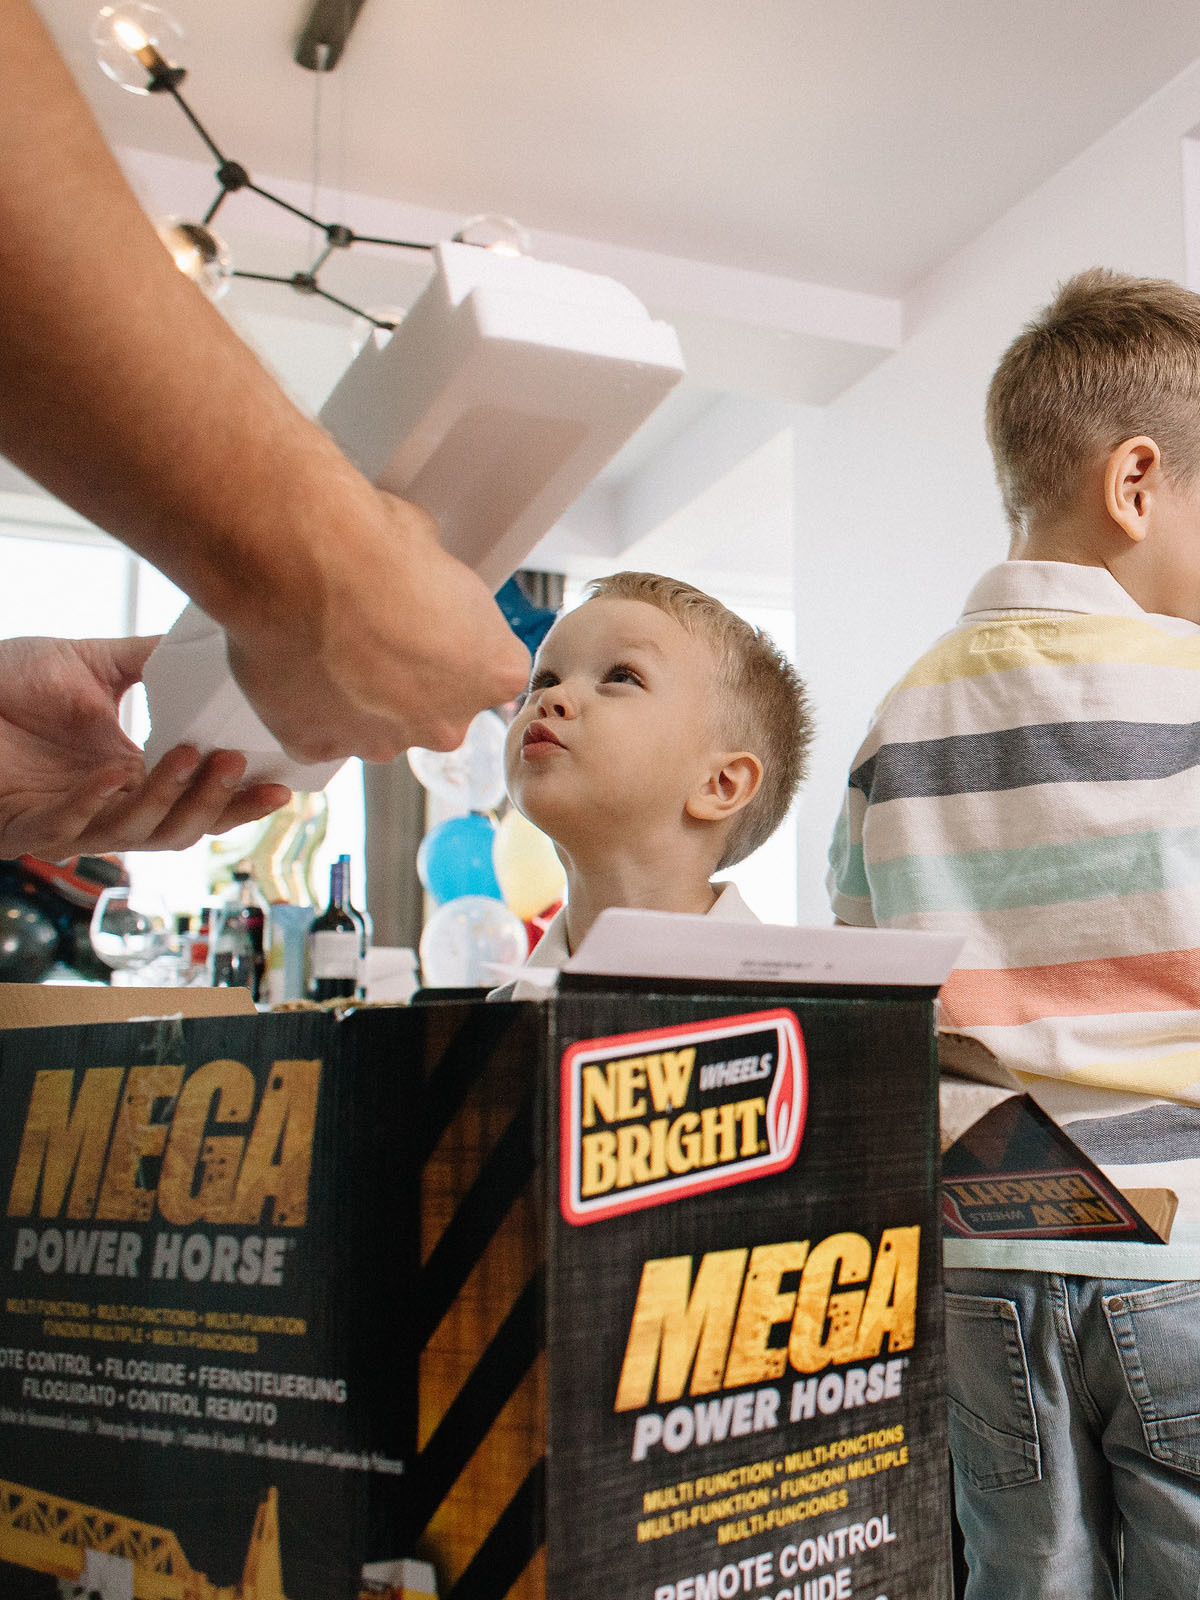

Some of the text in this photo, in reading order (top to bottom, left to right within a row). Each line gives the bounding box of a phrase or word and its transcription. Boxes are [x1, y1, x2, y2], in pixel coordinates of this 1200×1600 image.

[581, 1047, 774, 1128] NEW WHEELS
[6, 1058, 323, 1228] MEGA
[581, 1097, 766, 1197] BRIGHT
[951, 1177, 1096, 1207] BRIGHT
[1030, 1201, 1118, 1226] NEW
[12, 1228, 287, 1286] POWER HORSE
[614, 1224, 921, 1413] MEGA
[26, 1351, 94, 1377] CONTROL
[104, 1357, 187, 1387] FILOGUIDE
[198, 1365, 347, 1403] FERNSTEUERUNG
[127, 1388, 203, 1418] CONTROL
[204, 1396, 278, 1426] REMOTO
[631, 1359, 903, 1462] POWER HORSE
[643, 1481, 694, 1514] MULTI
[695, 1459, 775, 1499] FUNCTION
[847, 1446, 909, 1480] MULTIPLE
[779, 1513, 897, 1579] CONTROL
